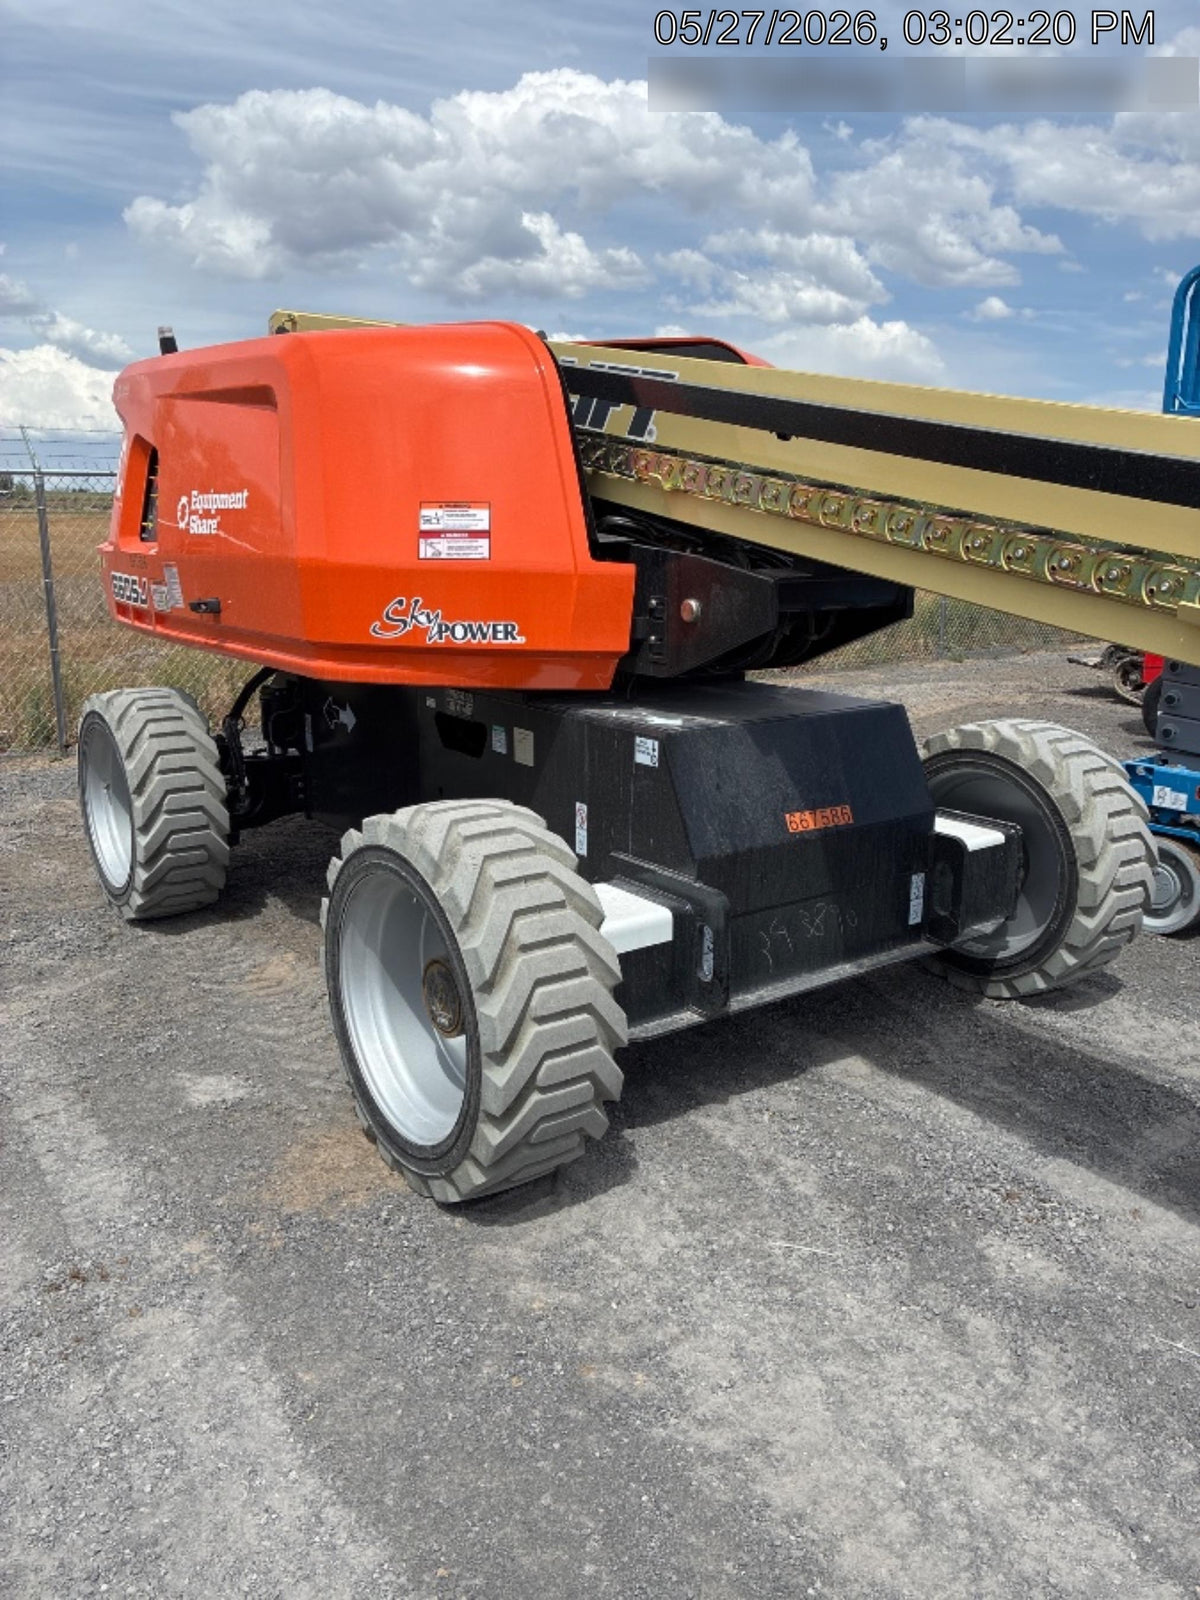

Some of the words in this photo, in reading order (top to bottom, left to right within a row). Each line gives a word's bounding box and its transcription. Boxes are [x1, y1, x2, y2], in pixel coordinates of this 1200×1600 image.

[190, 489, 249, 514] Equipment
[189, 515, 218, 535] Share
[788, 805, 852, 832] 667586
